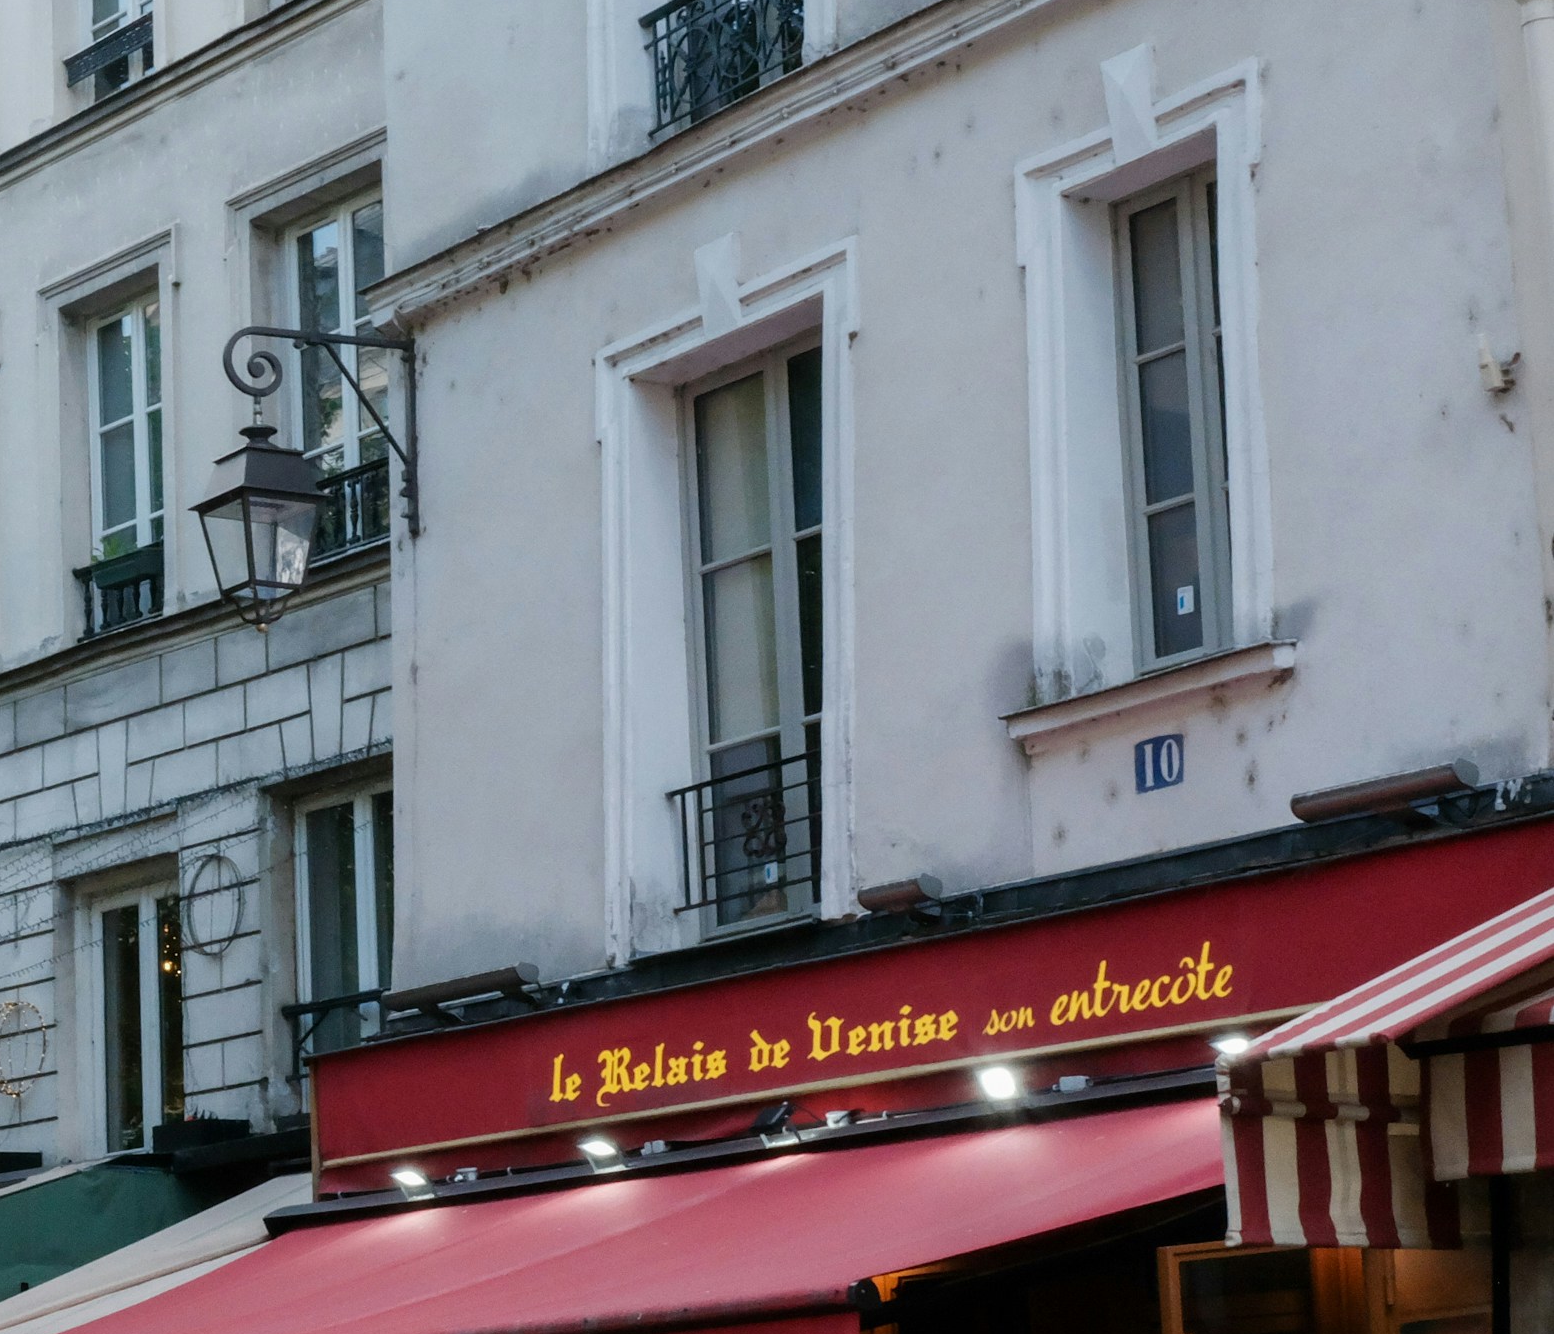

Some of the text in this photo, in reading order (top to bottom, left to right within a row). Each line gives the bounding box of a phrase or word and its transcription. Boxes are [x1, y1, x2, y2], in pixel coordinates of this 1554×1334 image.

[1144, 739, 1180, 787] 10
[549, 941, 1233, 1107] le Relais de Venise son entrecôte
